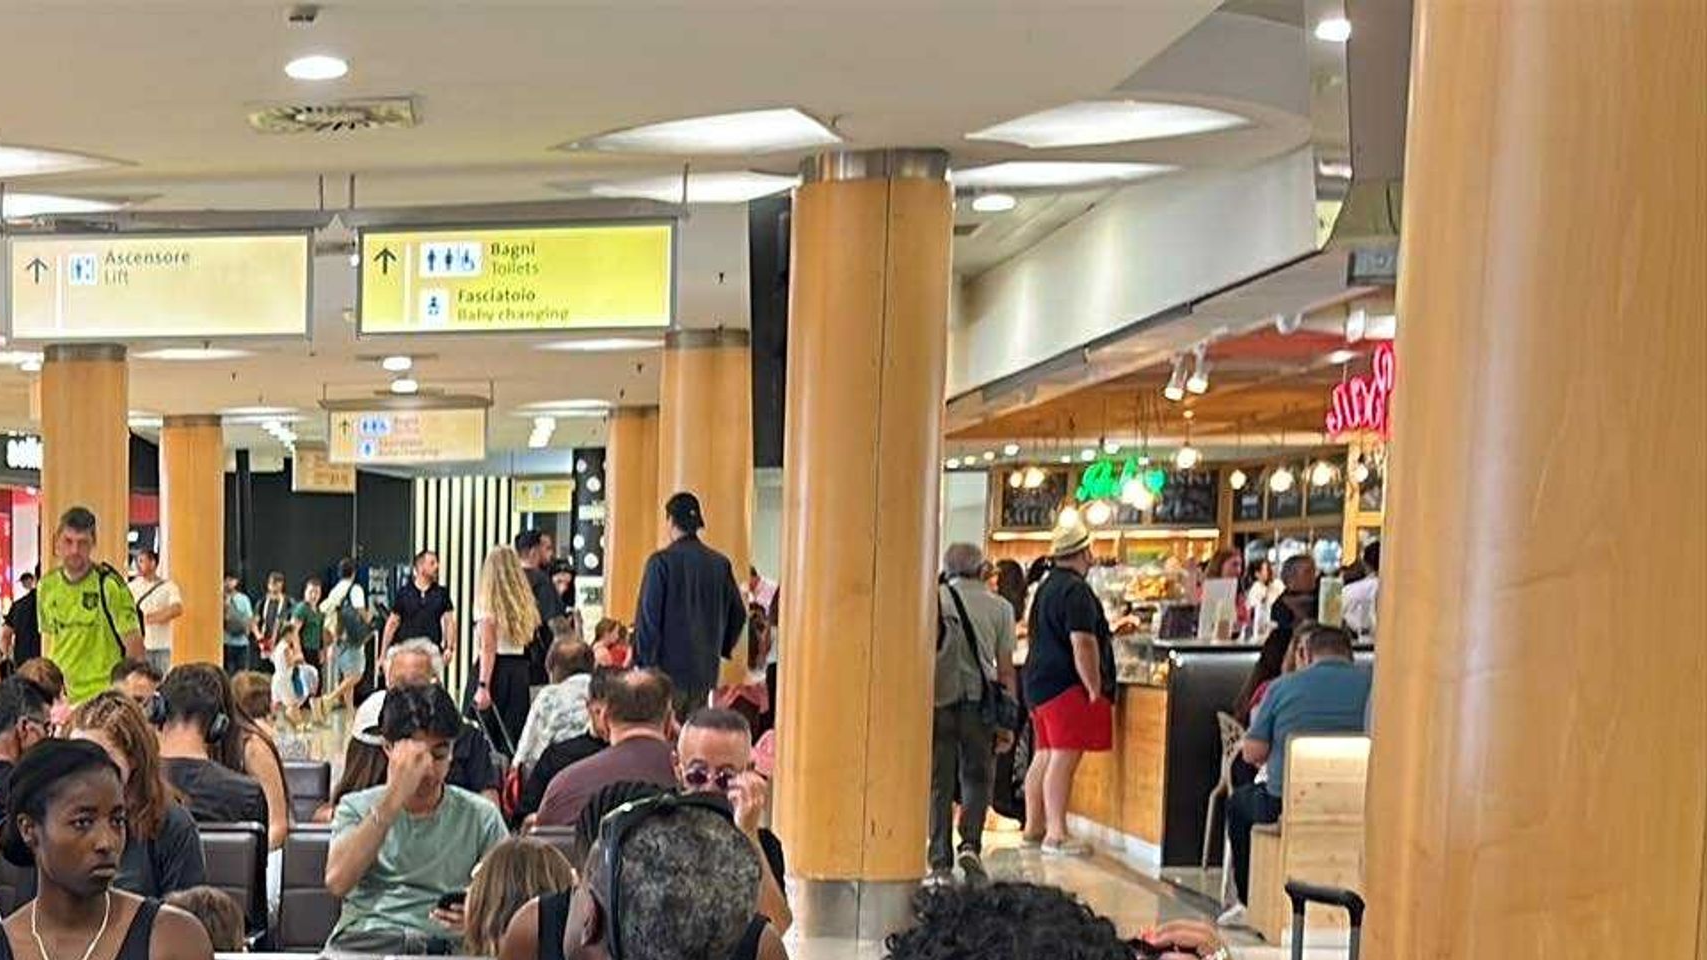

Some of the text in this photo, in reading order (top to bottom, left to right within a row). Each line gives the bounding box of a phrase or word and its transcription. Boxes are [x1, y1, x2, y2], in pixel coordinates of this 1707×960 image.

[104, 249, 190, 265] Ascensore
[490, 242, 536, 259] Bagni
[104, 267, 129, 286] Lift
[492, 261, 540, 277] Toilets
[458, 287, 536, 302] Fasciatoio
[458, 306, 569, 322] Baby changing
